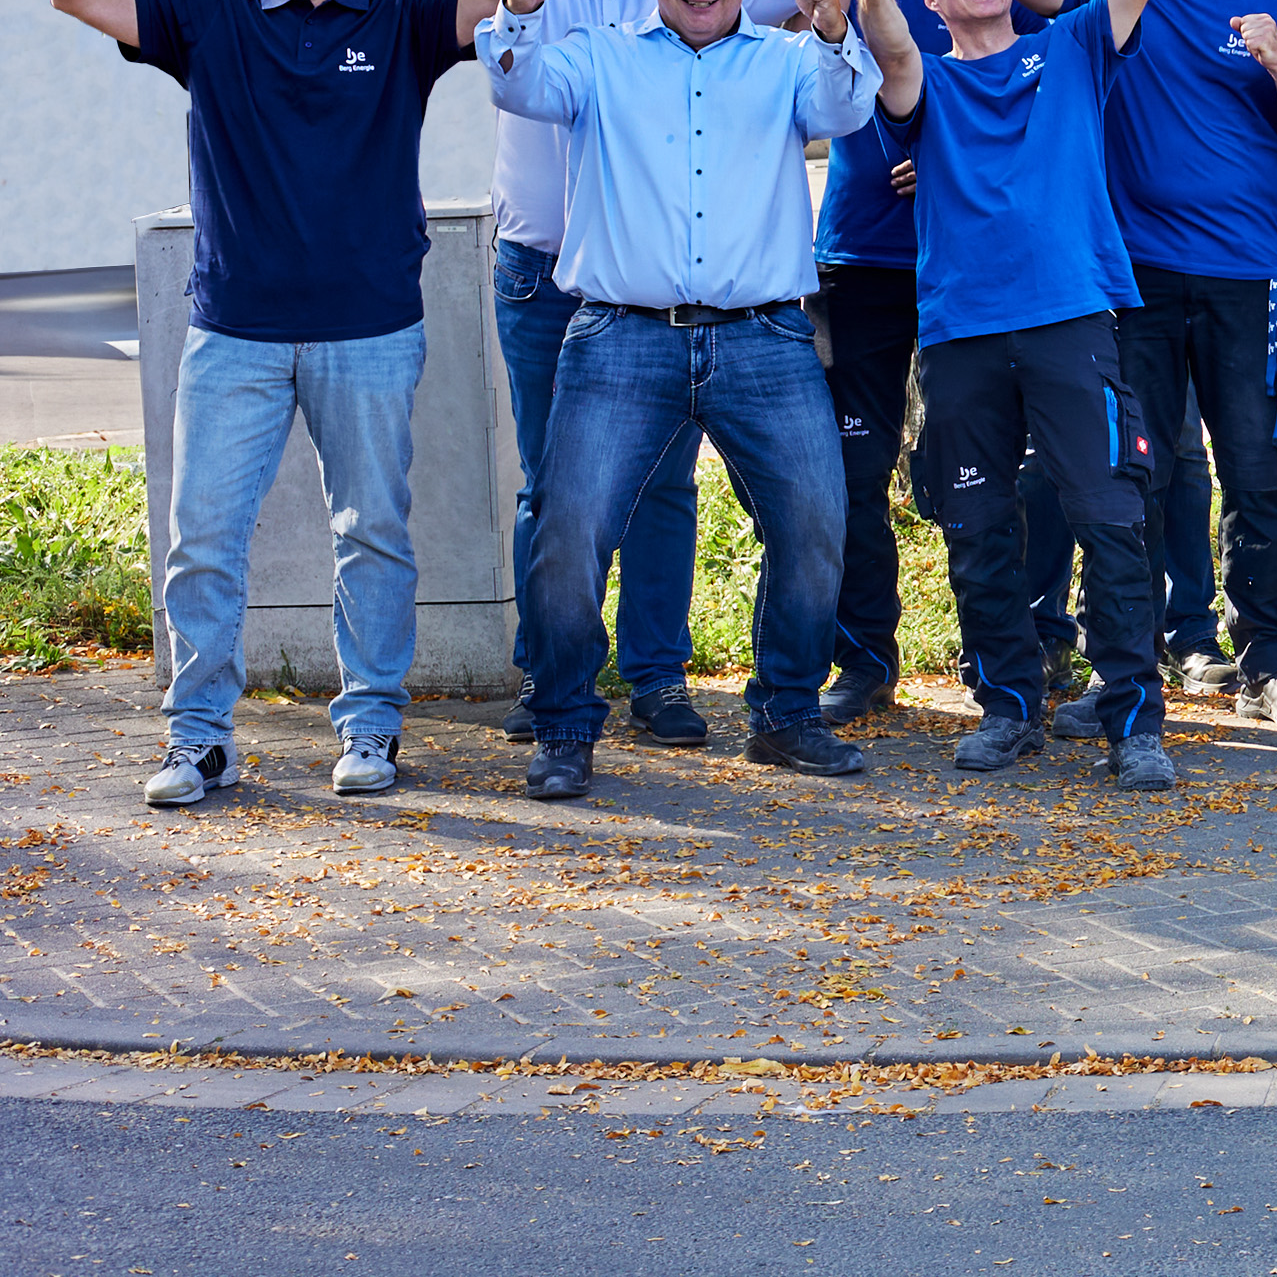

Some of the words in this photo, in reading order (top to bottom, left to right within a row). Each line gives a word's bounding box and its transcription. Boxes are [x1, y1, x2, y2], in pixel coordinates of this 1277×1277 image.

[346, 48, 367, 65] be
[1022, 54, 1041, 70] be
[339, 65, 353, 73] Berg
[844, 415, 862, 430] be
[960, 467, 978, 481] be
[966, 477, 986, 487] Energie
